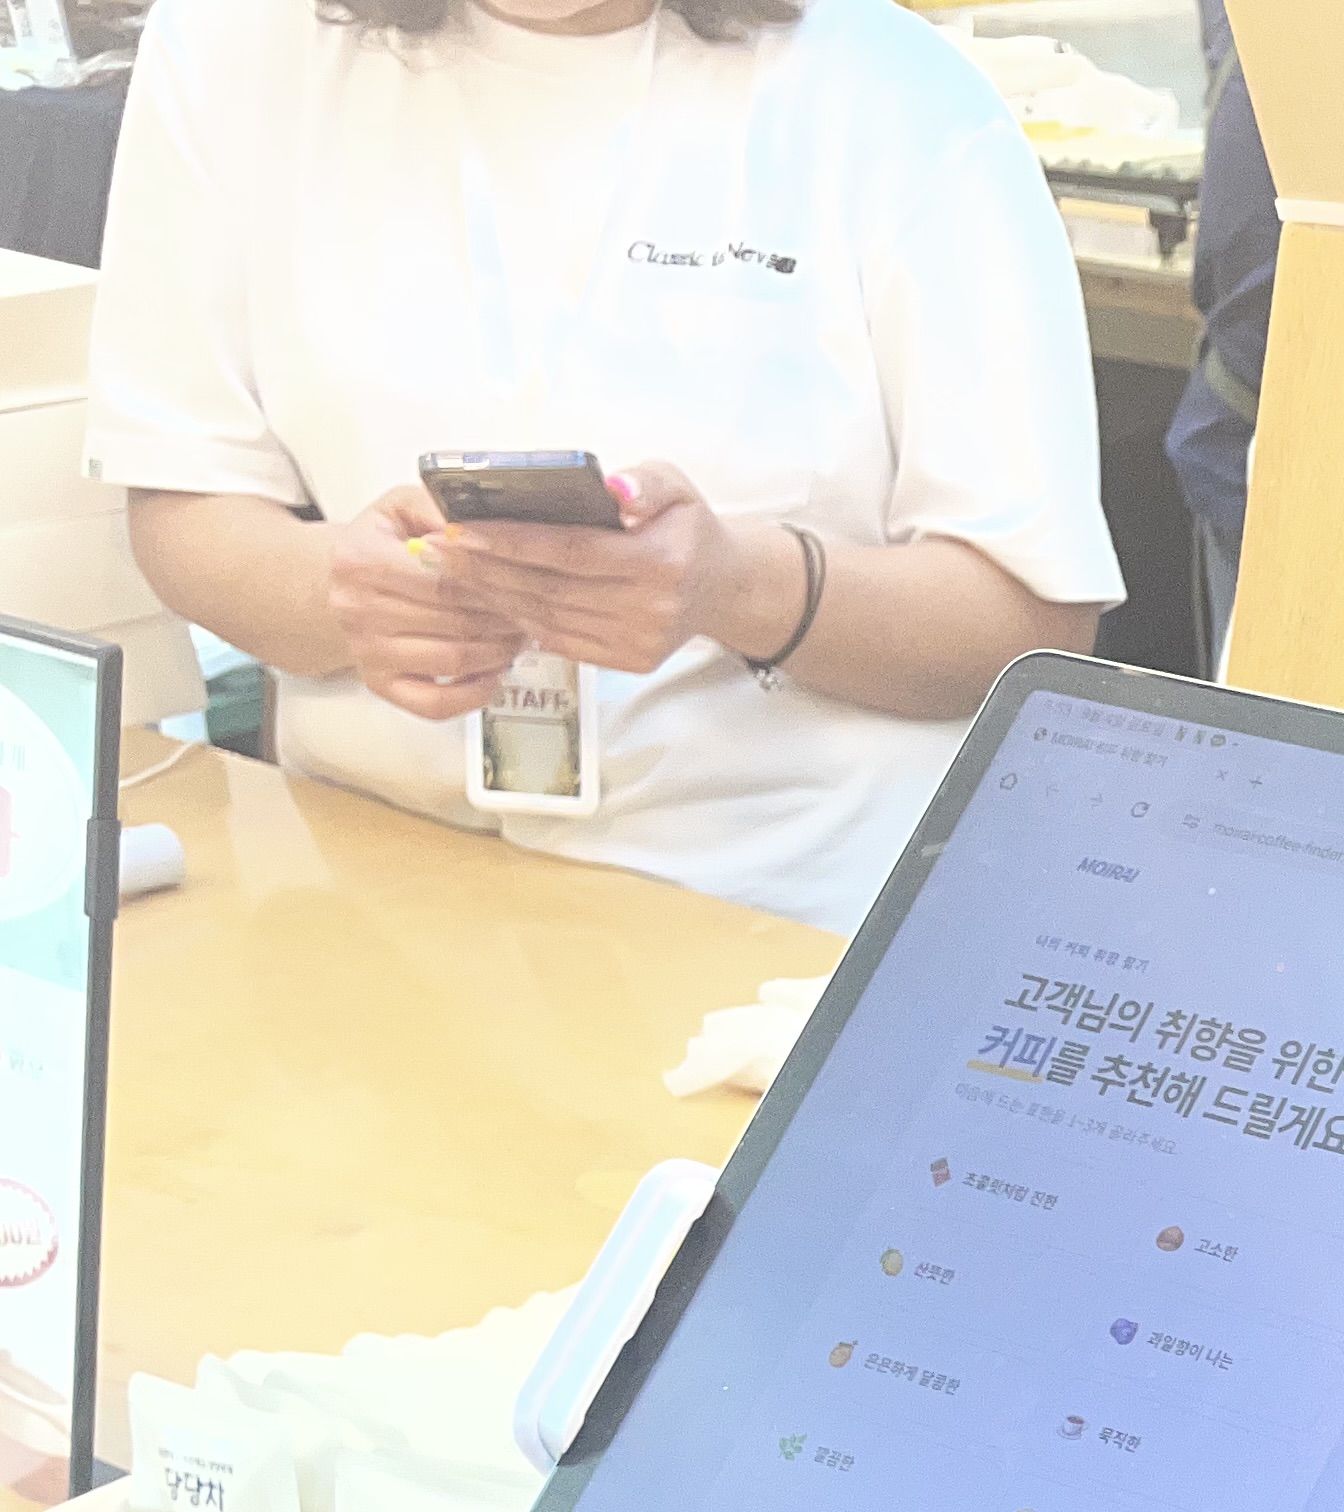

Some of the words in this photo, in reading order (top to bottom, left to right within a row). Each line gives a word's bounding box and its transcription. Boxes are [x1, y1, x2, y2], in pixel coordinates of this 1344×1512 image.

[1077, 857, 1140, 883] MOIRAI
[1004, 972, 1155, 1044] 고객님의
[1155, 1007, 1268, 1073] 취향을
[977, 1023, 1090, 1087] 커피를
[1090, 1053, 1207, 1119] 추천해
[1194, 1237, 1240, 1263] 고소한
[1205, 1348, 1235, 1371] 나는
